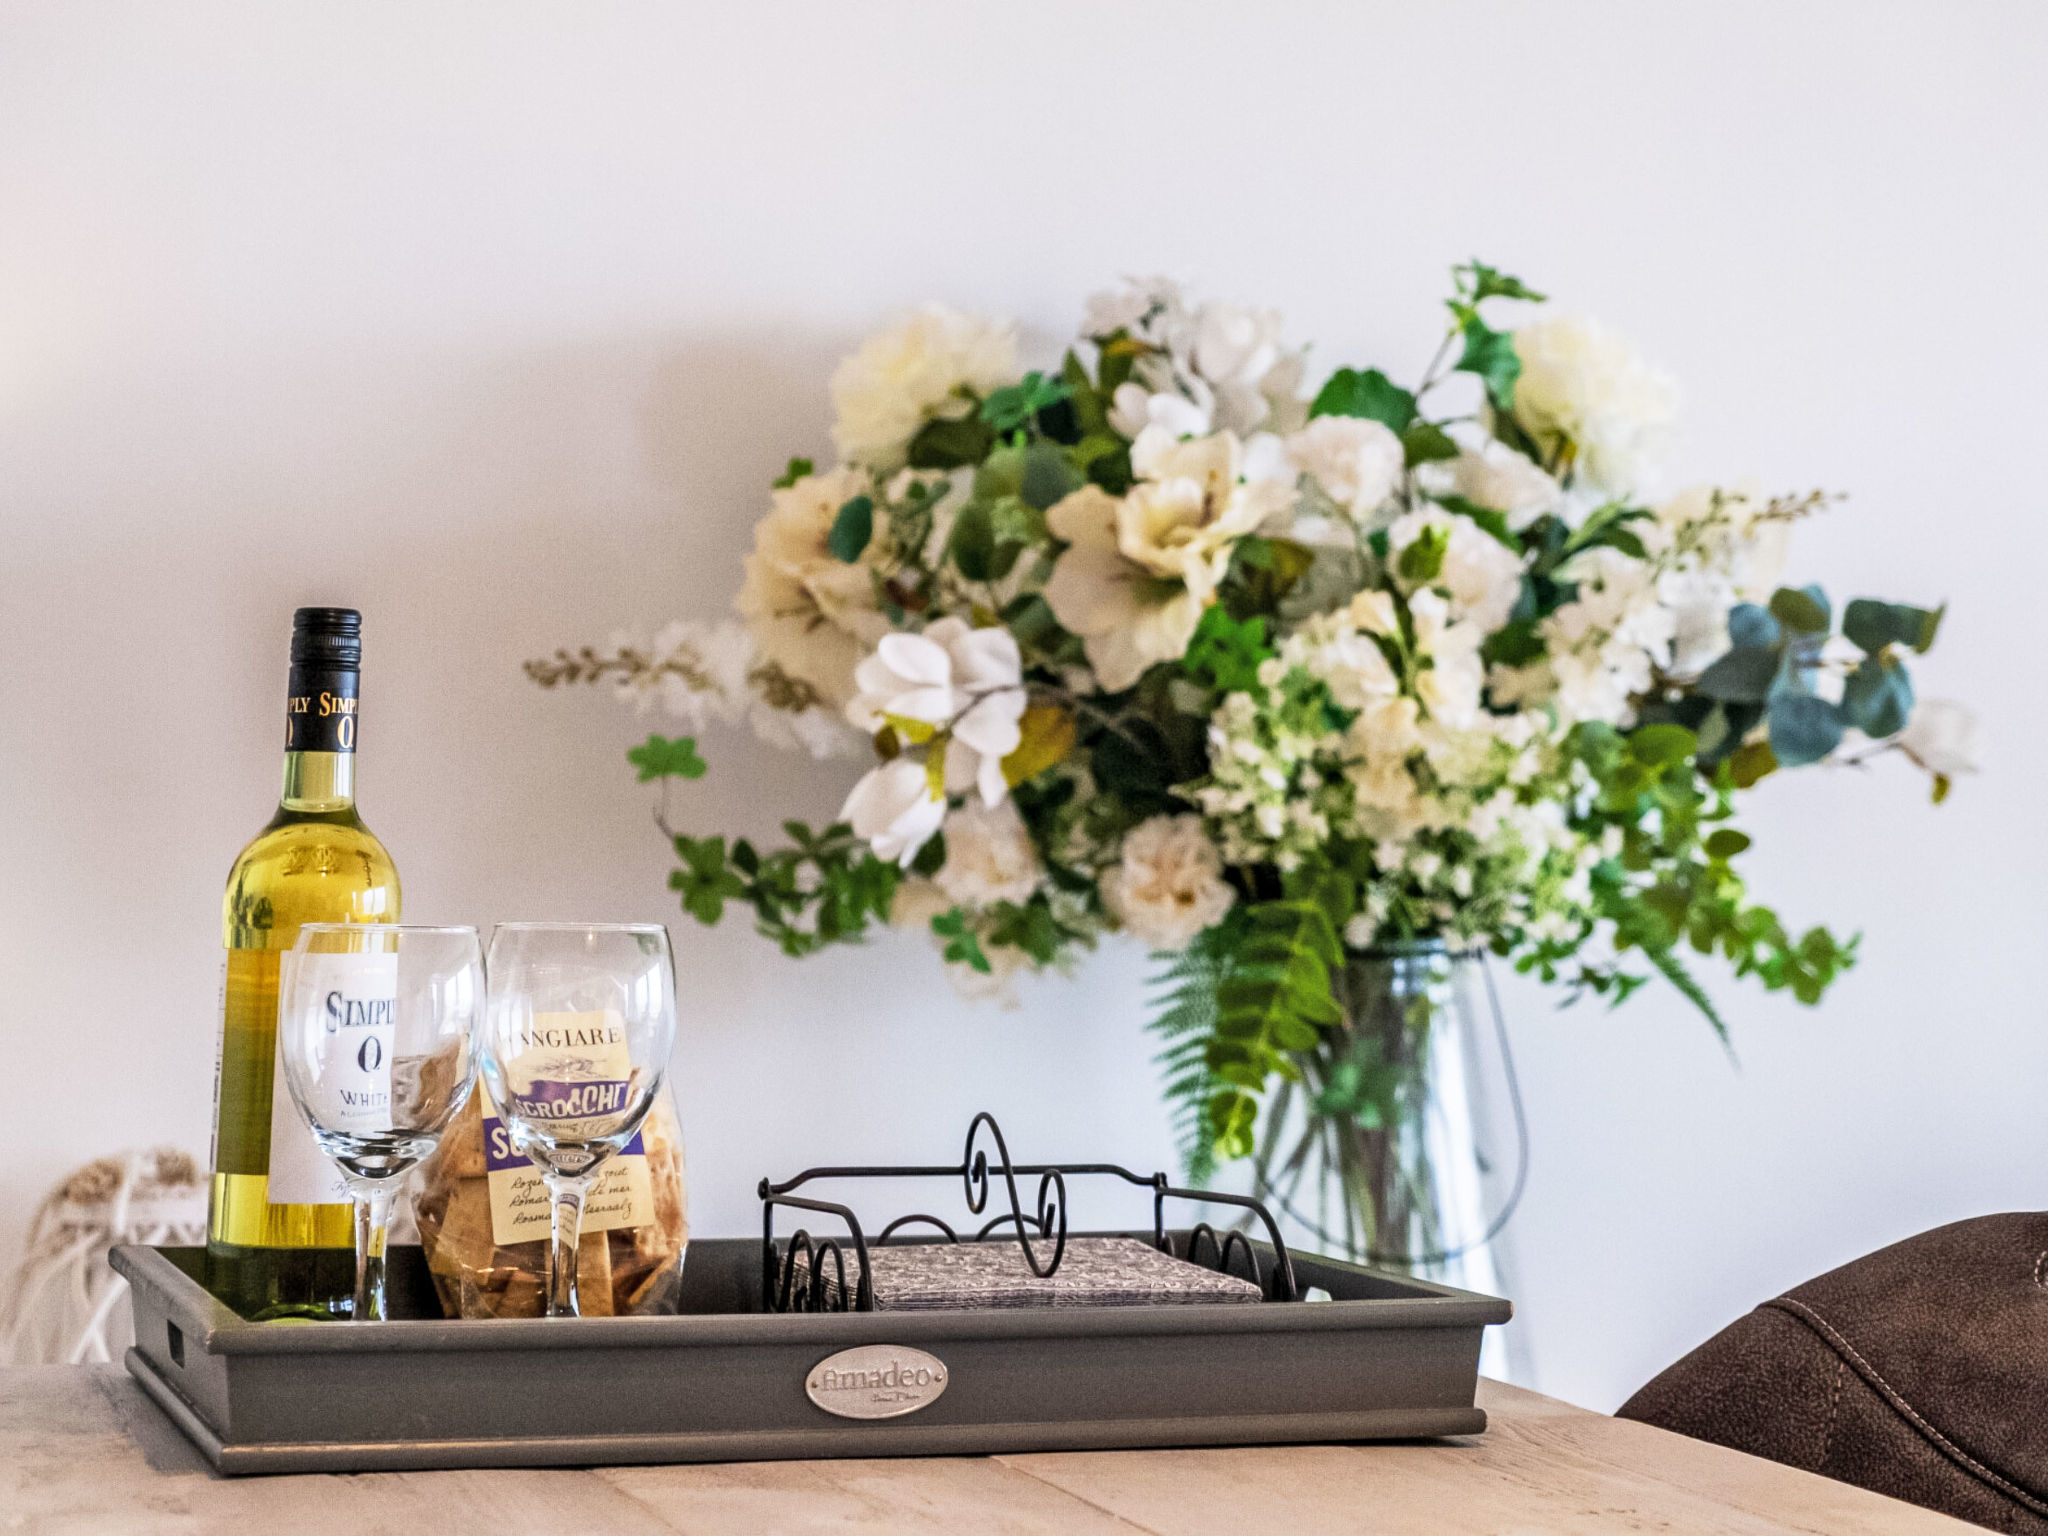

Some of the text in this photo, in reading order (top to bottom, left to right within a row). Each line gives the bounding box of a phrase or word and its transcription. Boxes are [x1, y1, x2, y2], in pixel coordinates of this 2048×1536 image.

[326, 990, 395, 1033] SIMPL
[520, 1027, 621, 1048] ANGIARE
[822, 1360, 931, 1391] Amadeo
